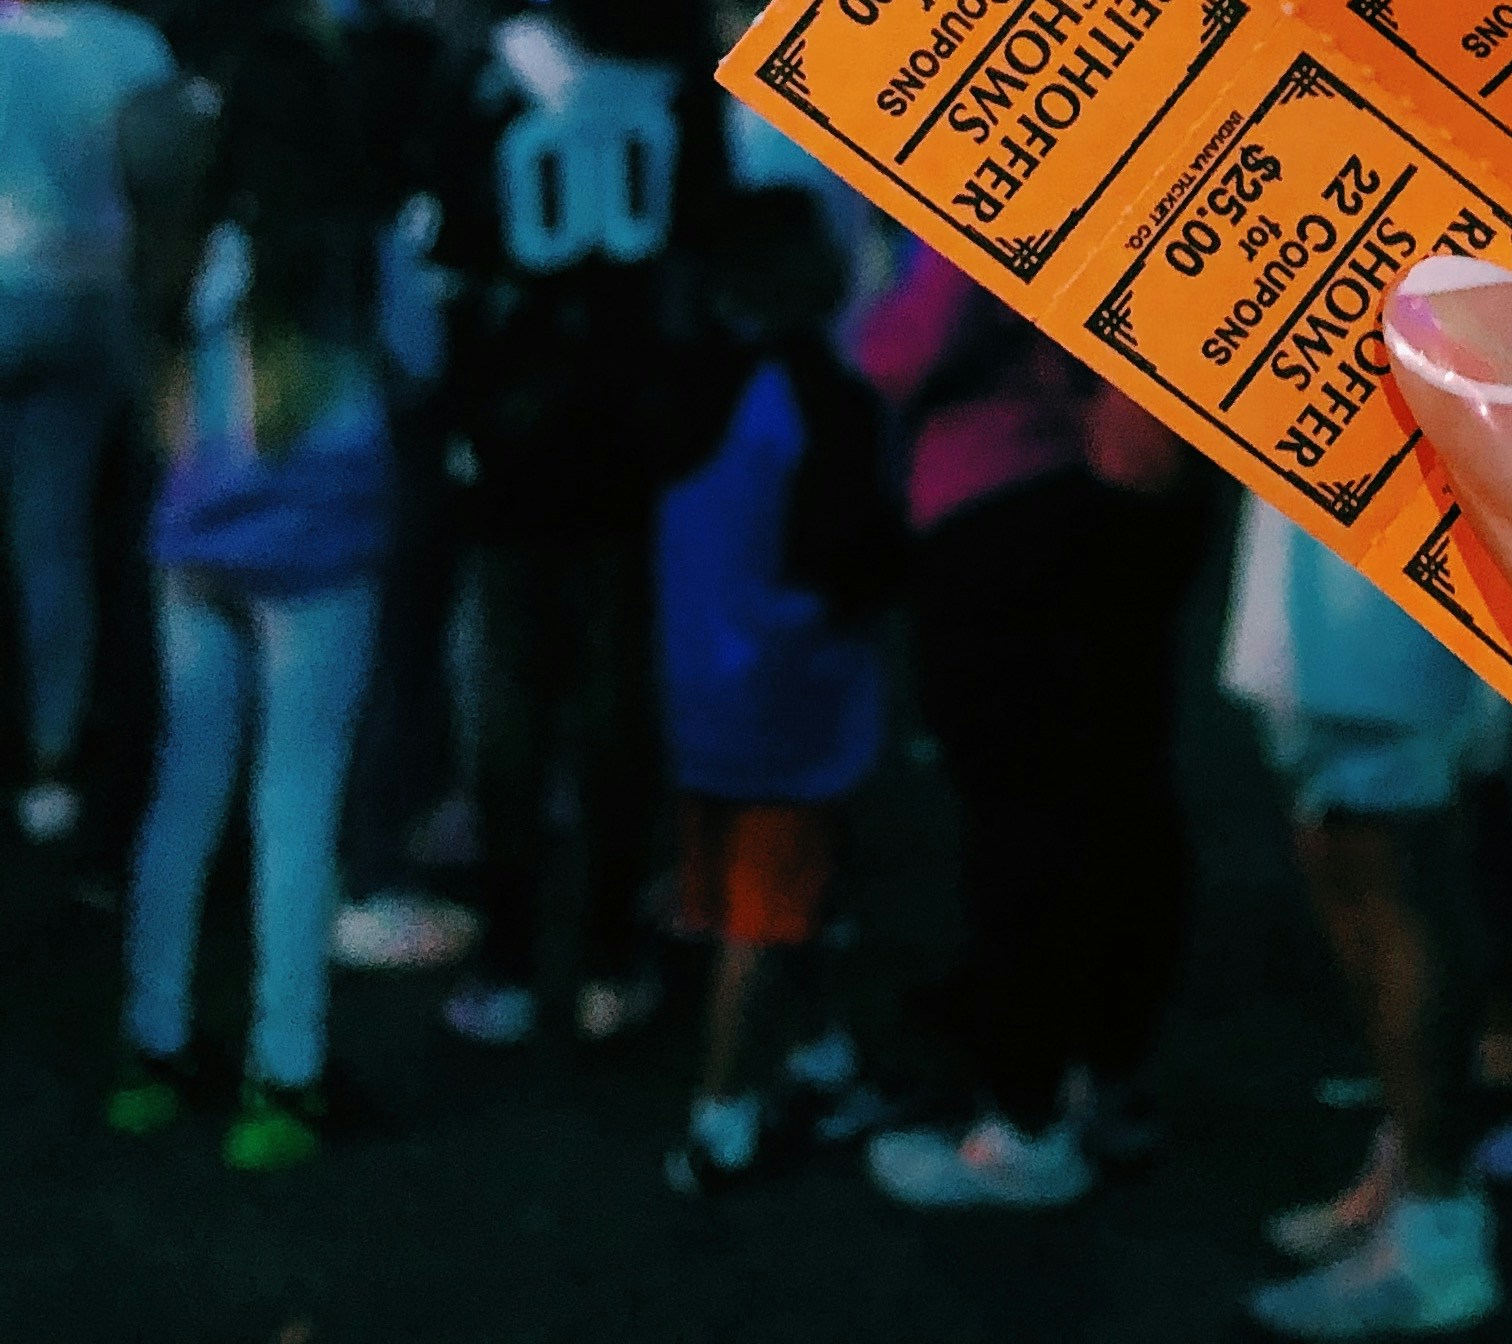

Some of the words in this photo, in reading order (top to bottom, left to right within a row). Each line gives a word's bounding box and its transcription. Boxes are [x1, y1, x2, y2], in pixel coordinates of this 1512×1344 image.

[1188, 110, 1244, 172] INDIANA
[1149, 172, 1197, 227] TICKET
[1164, 143, 1282, 278] $25.00
[1320, 153, 1381, 216] 22
[1238, 214, 1283, 262] for
[1201, 214, 1337, 367] COUPONS
[1270, 216, 1417, 392] SHOWS
